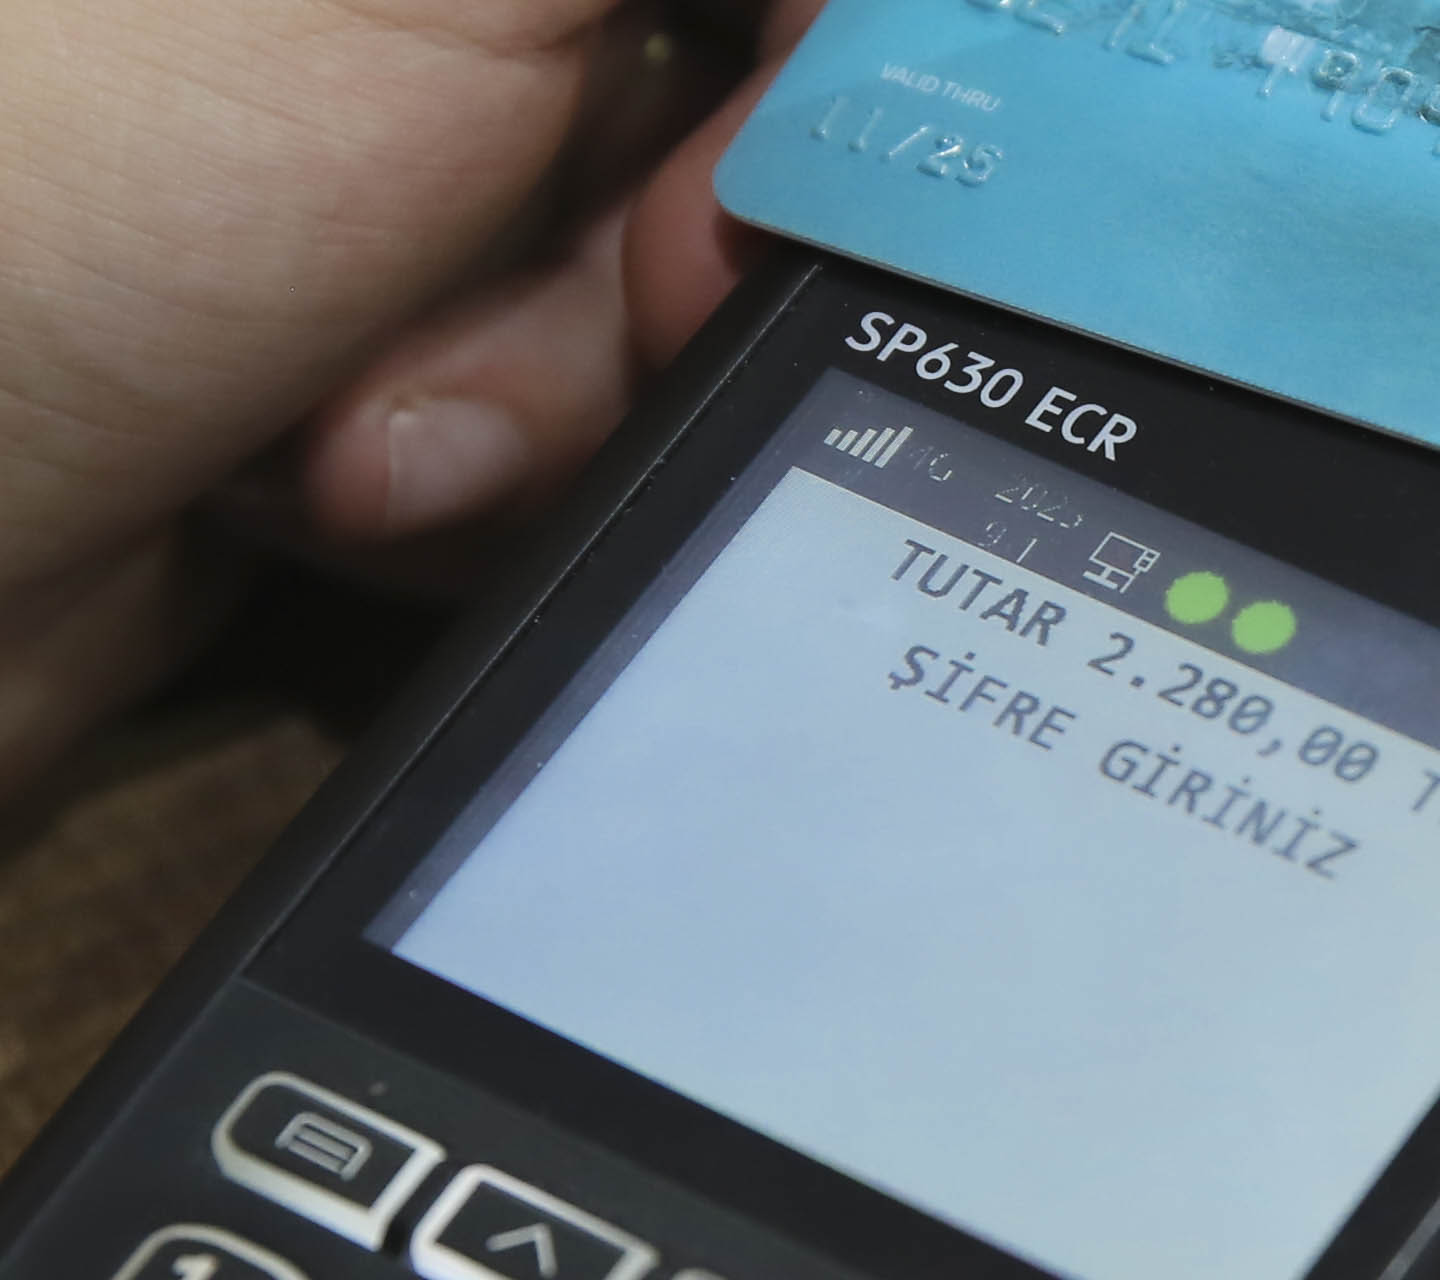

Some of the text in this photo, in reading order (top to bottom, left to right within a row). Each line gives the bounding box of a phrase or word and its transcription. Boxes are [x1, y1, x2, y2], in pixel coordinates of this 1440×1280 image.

[880, 63, 1001, 113] VALID THRU
[844, 311, 1138, 462] SP630 ECR
[891, 538, 1067, 646] TUTAR
[1087, 632, 1379, 782] 2.280,00
[888, 645, 1359, 879] ŞİFRE GİRİNİZ
